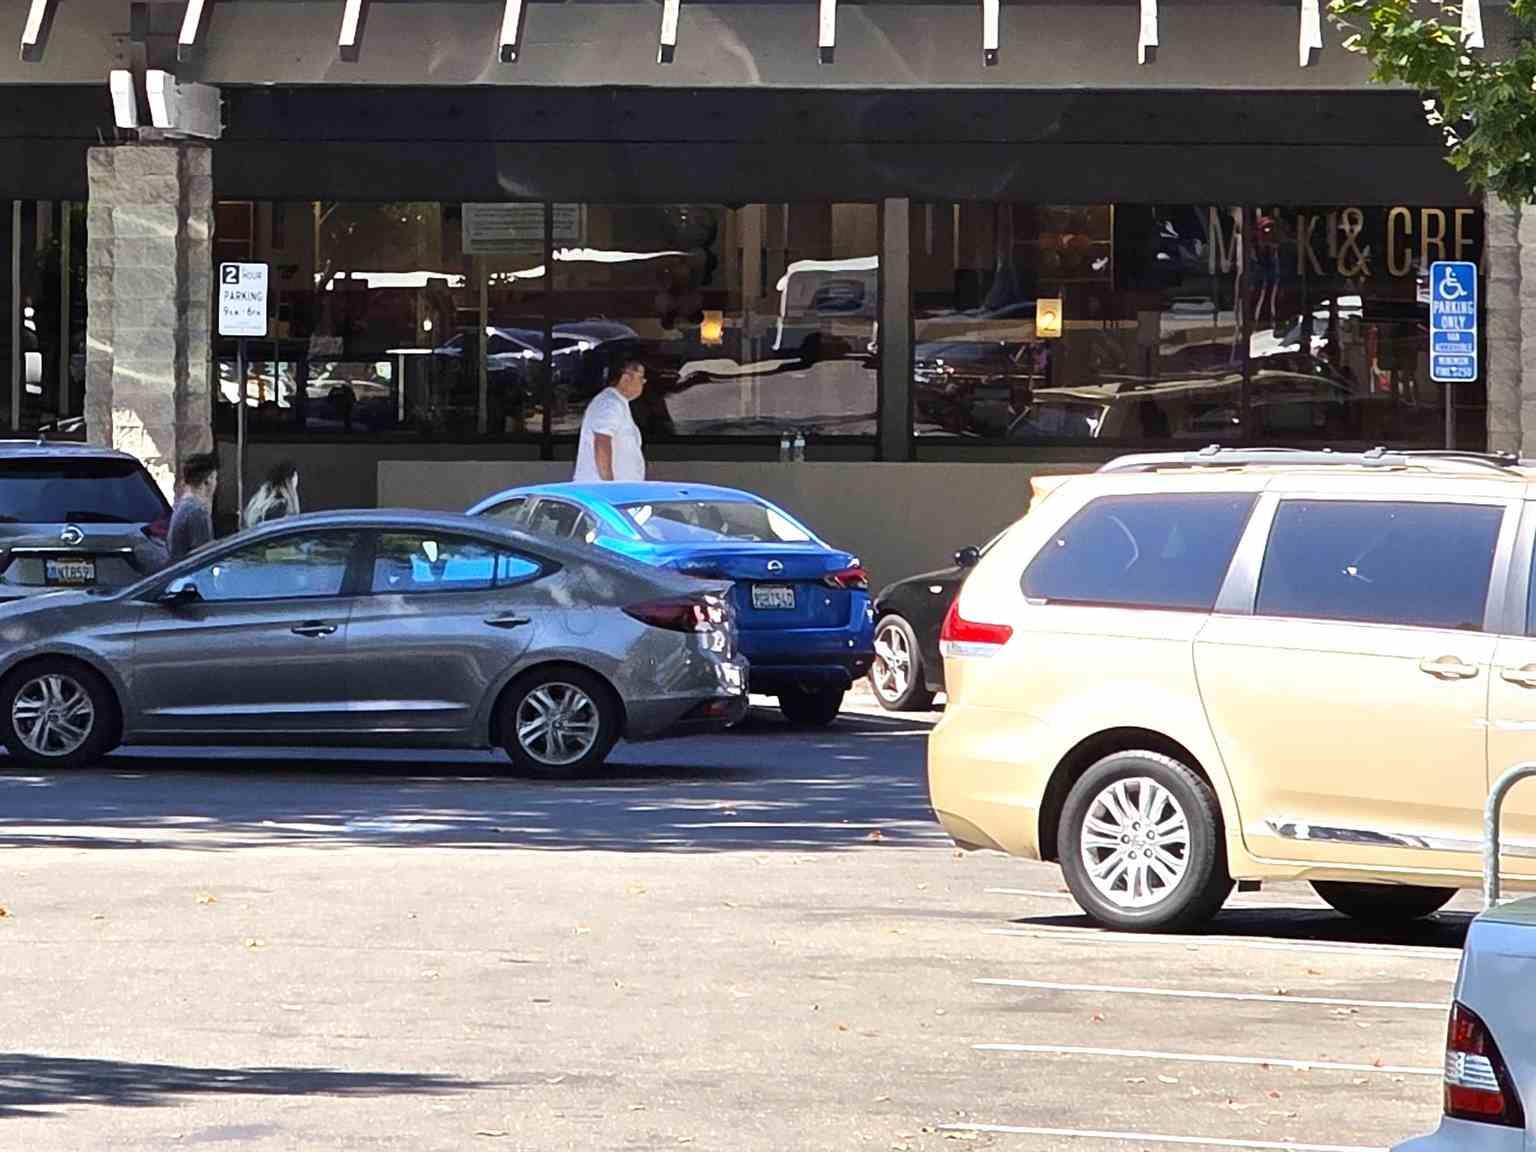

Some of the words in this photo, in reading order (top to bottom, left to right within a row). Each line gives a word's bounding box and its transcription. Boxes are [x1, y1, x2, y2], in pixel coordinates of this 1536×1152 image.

[1207, 206, 1325, 275] MK
[1336, 206, 1371, 277] &
[1386, 206, 1484, 277] CRE
[225, 266, 237, 283] 2
[224, 290, 263, 302] PARKING
[1433, 300, 1473, 314] PARKING
[1440, 315, 1467, 329] ONLY
